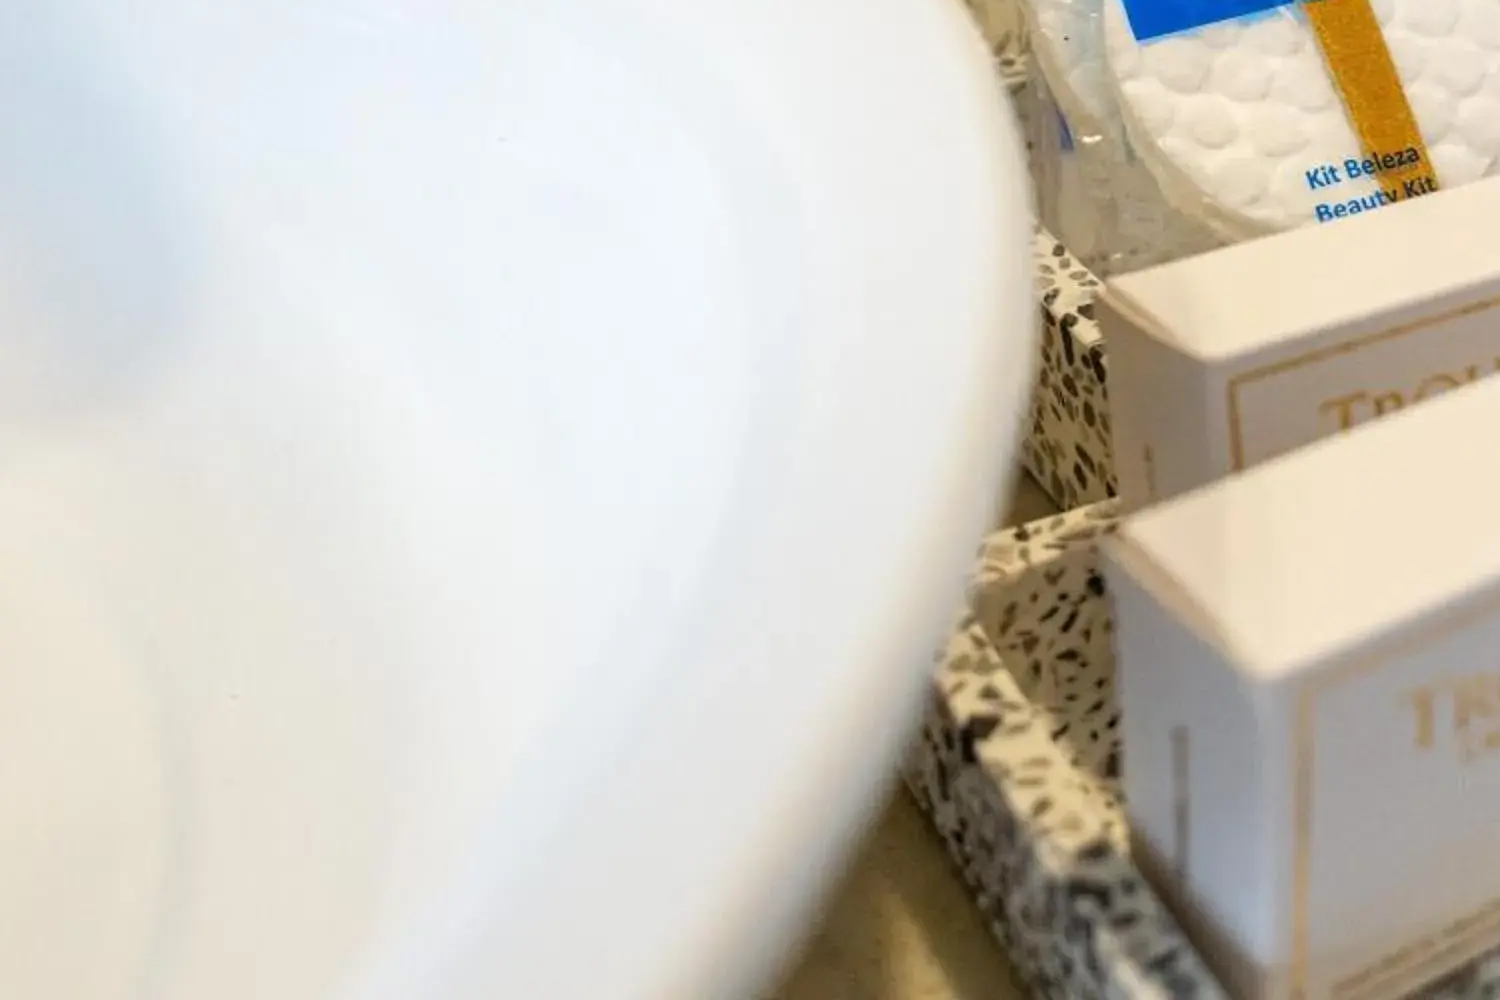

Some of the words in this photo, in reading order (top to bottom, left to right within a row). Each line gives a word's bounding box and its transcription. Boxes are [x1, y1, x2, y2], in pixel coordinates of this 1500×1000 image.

[1304, 164, 1342, 190] Kit
[1343, 147, 1421, 179] Beleza
[1403, 175, 1439, 199] Kit
